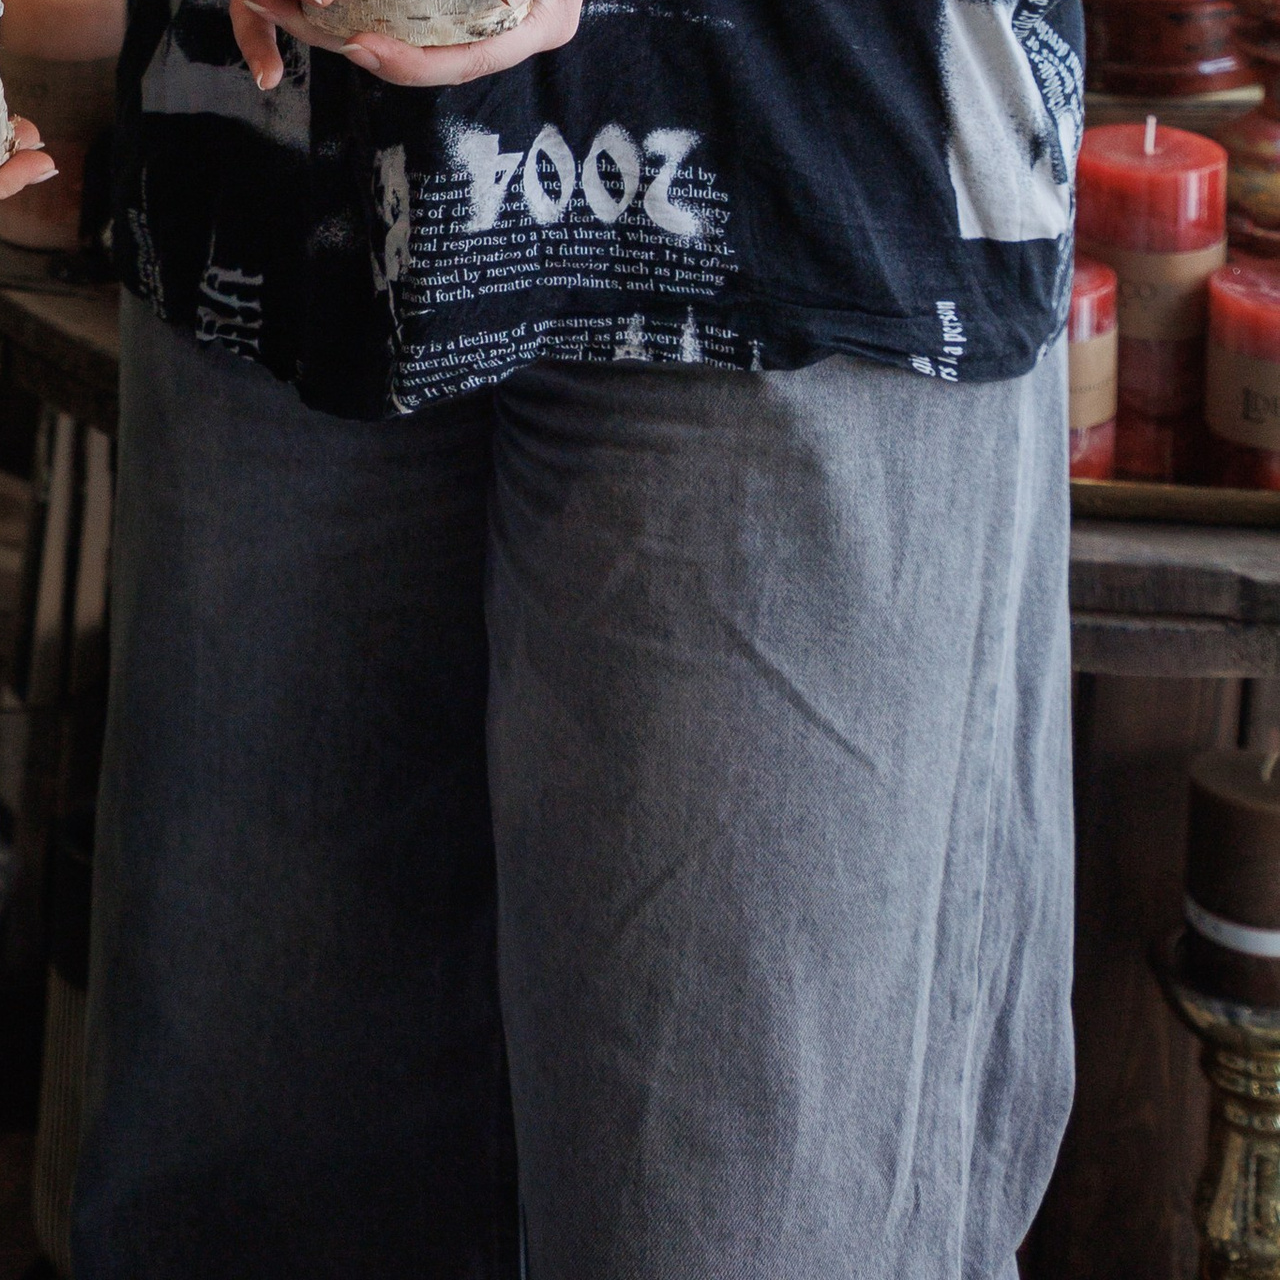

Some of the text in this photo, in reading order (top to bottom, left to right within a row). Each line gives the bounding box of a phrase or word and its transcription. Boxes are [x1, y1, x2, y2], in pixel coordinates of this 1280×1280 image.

[435, 171, 447, 184] is
[699, 166, 718, 185] by
[416, 187, 472, 203] leasant
[667, 184, 729, 203] includes
[427, 204, 447, 220] of
[519, 214, 533, 227] in
[619, 212, 658, 228] defin
[442, 232, 508, 253] response
[511, 231, 526, 244] to
[541, 227, 569, 241] real
[573, 227, 622, 242] threat,
[626, 229, 691, 250] whereas
[434, 248, 522, 268] anticipation
[524, 242, 541, 258] of
[559, 243, 604, 258] future
[609, 244, 660, 262] threat.
[664, 248, 678, 263] It
[682, 252, 695, 267] is
[463, 267, 482, 285] by
[486, 261, 542, 279] nervous
[614, 262, 650, 276] such
[654, 265, 671, 277] as
[675, 268, 726, 287] pacing
[435, 286, 476, 304] forth,
[478, 276, 533, 296] somatic
[535, 272, 624, 291] complaints,
[626, 278, 655, 292] and
[429, 339, 443, 353] is
[458, 329, 510, 349] feeling
[511, 322, 528, 337] of
[533, 315, 613, 333] uneasiness
[705, 325, 740, 339] usu-
[935, 301, 967, 342] person
[399, 348, 486, 375] generalized
[594, 331, 612, 343] as
[424, 386, 442, 400] It
[443, 382, 459, 395] is
[459, 373, 499, 391] often
